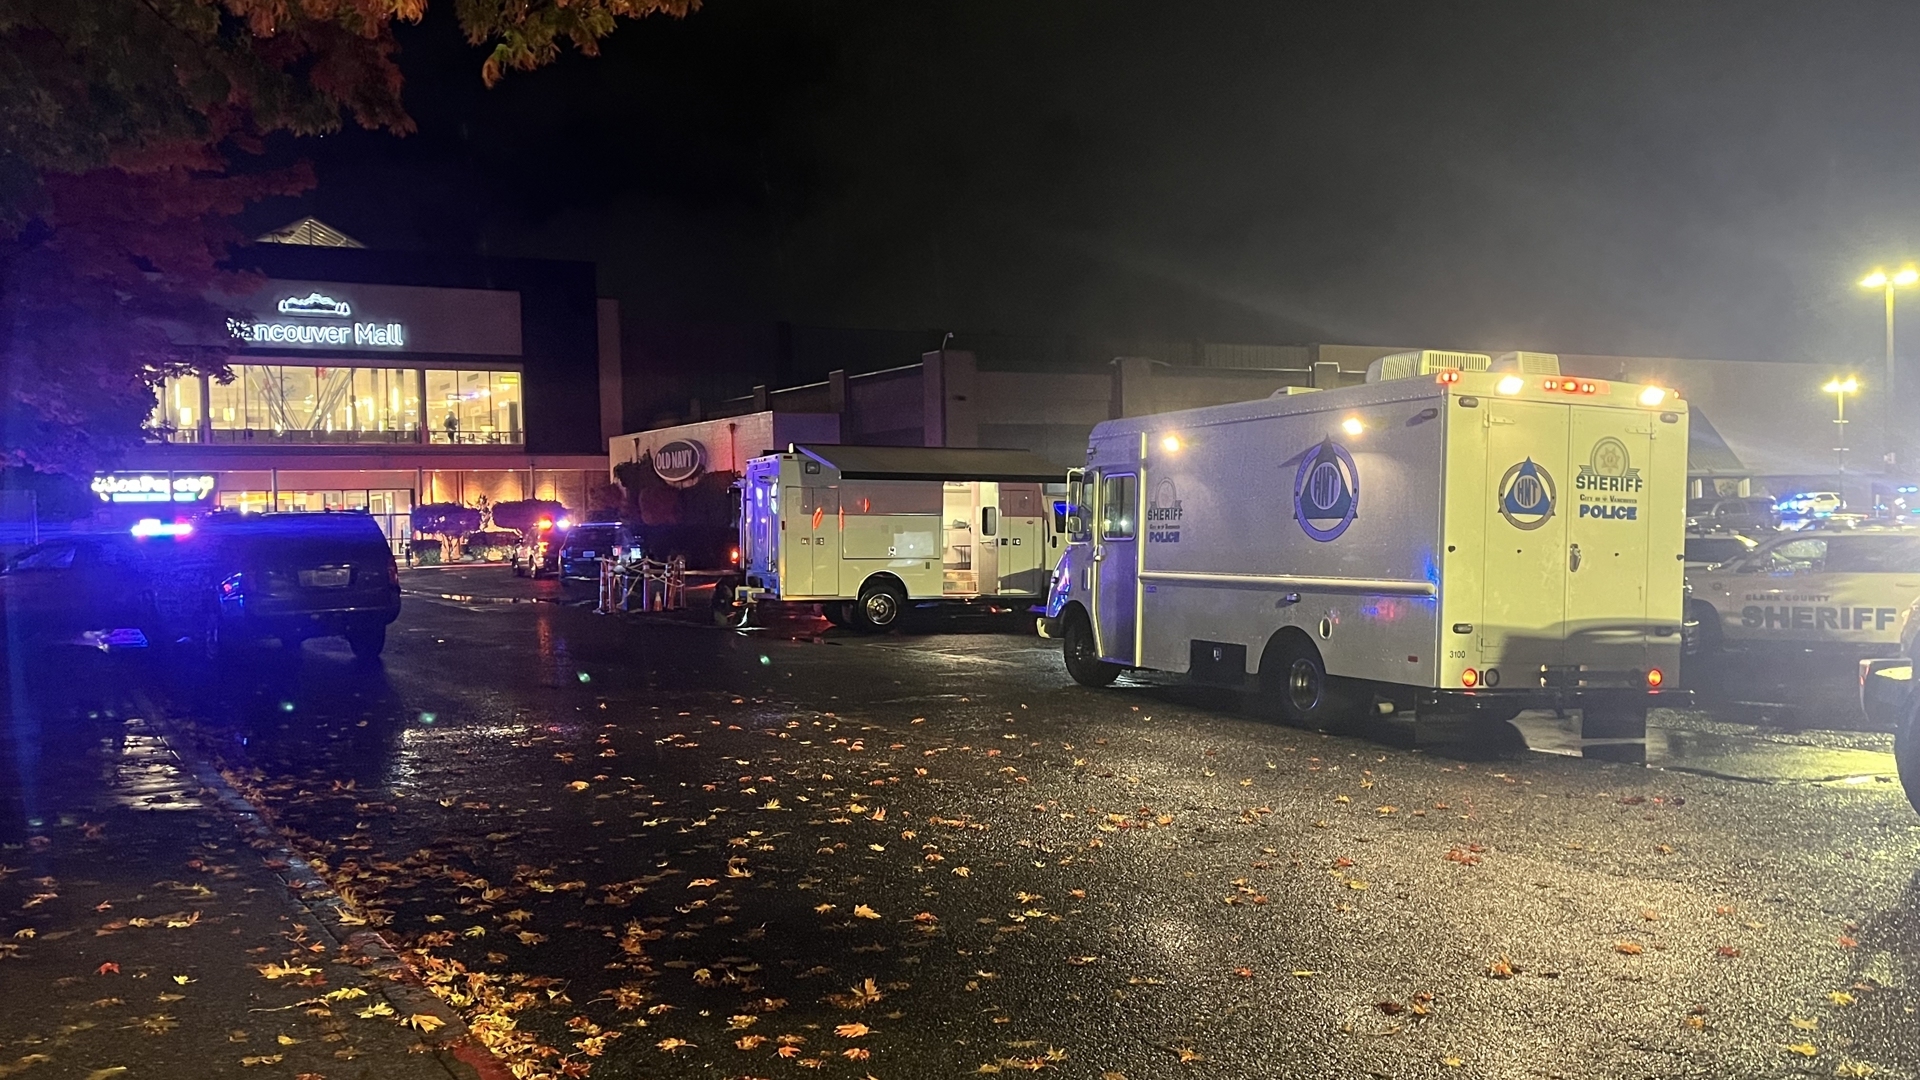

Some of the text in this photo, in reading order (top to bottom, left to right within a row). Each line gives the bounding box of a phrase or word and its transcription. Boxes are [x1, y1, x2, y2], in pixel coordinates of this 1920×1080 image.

[354, 322, 404, 346] Mall
[656, 449, 693, 470] OLD NAVY
[1517, 477, 1538, 507] HNT
[1576, 475, 1643, 493] SHERIFF
[1147, 508, 1183, 521] SHERIFF
[1579, 504, 1638, 520] POLICE
[1149, 531, 1180, 543] POLICE
[1745, 593, 1830, 602] CLARK COUNTY
[1741, 605, 1897, 631] SHERIFF
[1449, 650, 1466, 659] 3100
